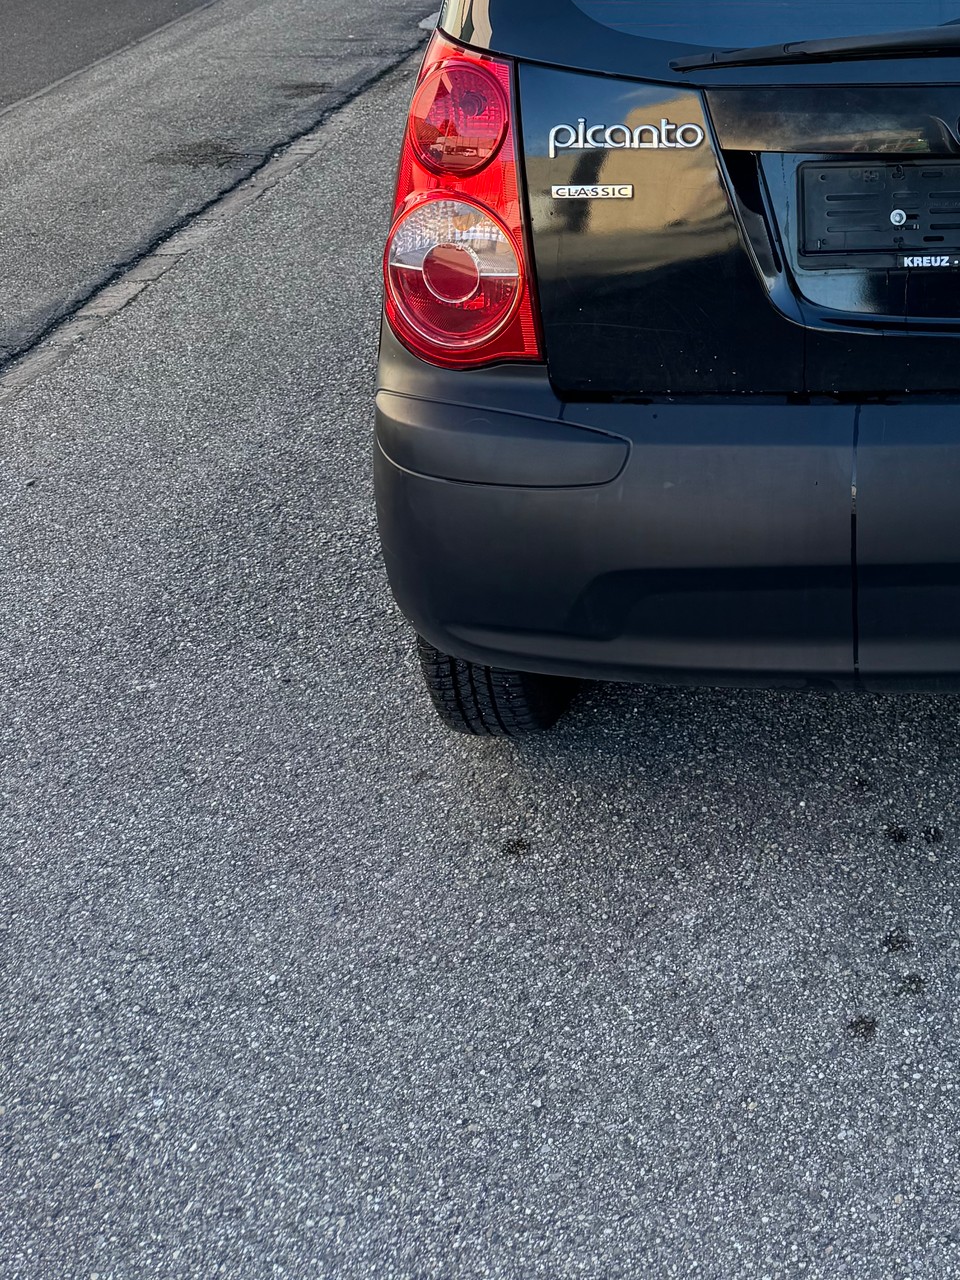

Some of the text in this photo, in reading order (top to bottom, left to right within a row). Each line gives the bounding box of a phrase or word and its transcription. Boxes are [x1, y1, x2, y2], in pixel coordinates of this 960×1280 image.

[548, 117, 705, 159] picanto
[555, 186, 629, 197] CLASSIC
[903, 255, 950, 268] KREUZ
